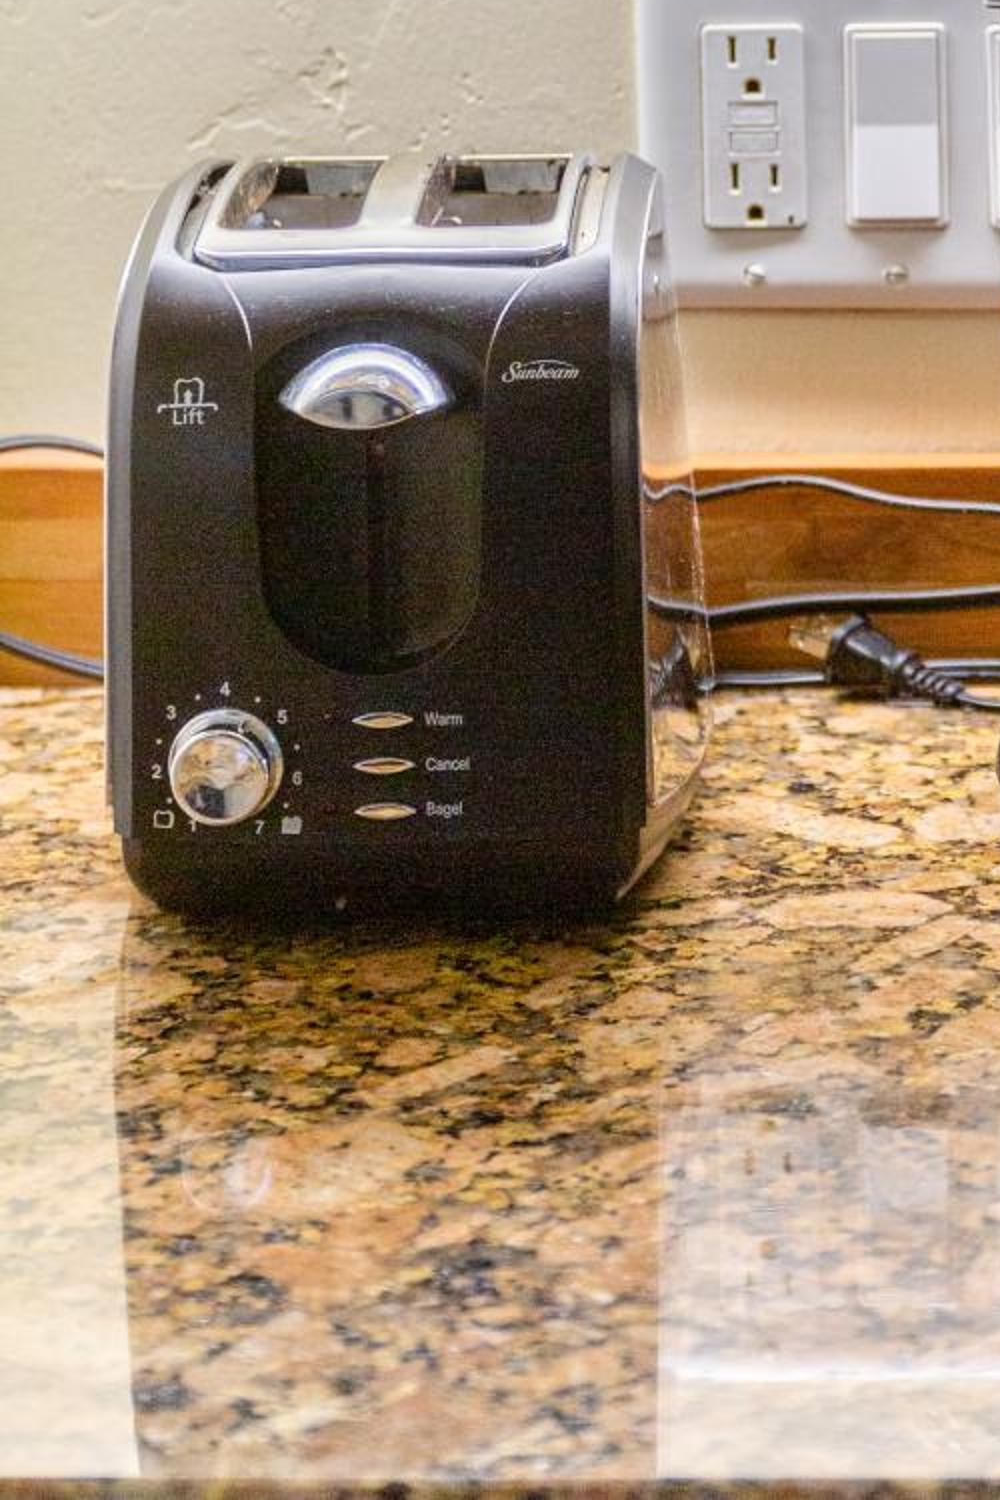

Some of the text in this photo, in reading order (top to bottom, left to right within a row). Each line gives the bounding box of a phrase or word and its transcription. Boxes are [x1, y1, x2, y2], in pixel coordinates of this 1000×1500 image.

[501, 359, 580, 383] Sunbeam
[173, 406, 206, 426] Lift
[219, 681, 231, 697] 4
[165, 705, 177, 720] 3
[277, 709, 288, 725] 5
[423, 710, 464, 726] Warm
[425, 755, 471, 772] Cancel
[151, 764, 162, 780] 2
[292, 771, 303, 786] 6
[425, 801, 464, 819] Bagel
[255, 819, 266, 835] 7
